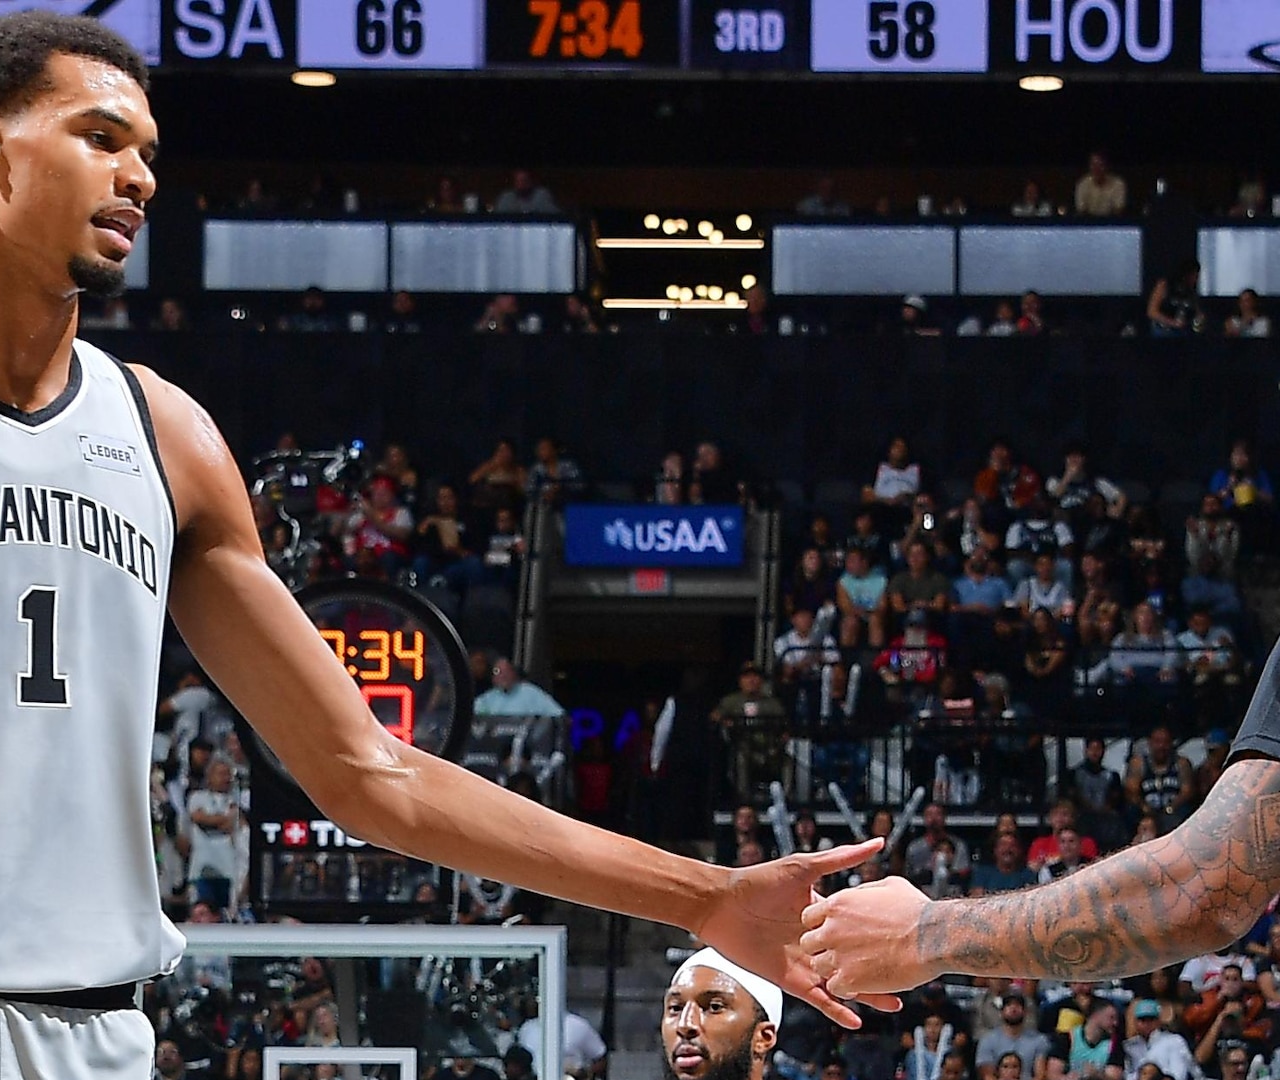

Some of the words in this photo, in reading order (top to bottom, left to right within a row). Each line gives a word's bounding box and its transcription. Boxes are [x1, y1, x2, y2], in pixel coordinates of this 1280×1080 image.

[173, 0, 283, 59] SA
[356, 0, 424, 57] 66
[528, 0, 643, 58] 7:34
[713, 10, 784, 52] 3RD
[867, 0, 936, 60] 58
[1015, 0, 1173, 63] HOU
[88, 442, 132, 465] LEDGER
[635, 518, 728, 554] USAA
[16, 585, 72, 708] 1
